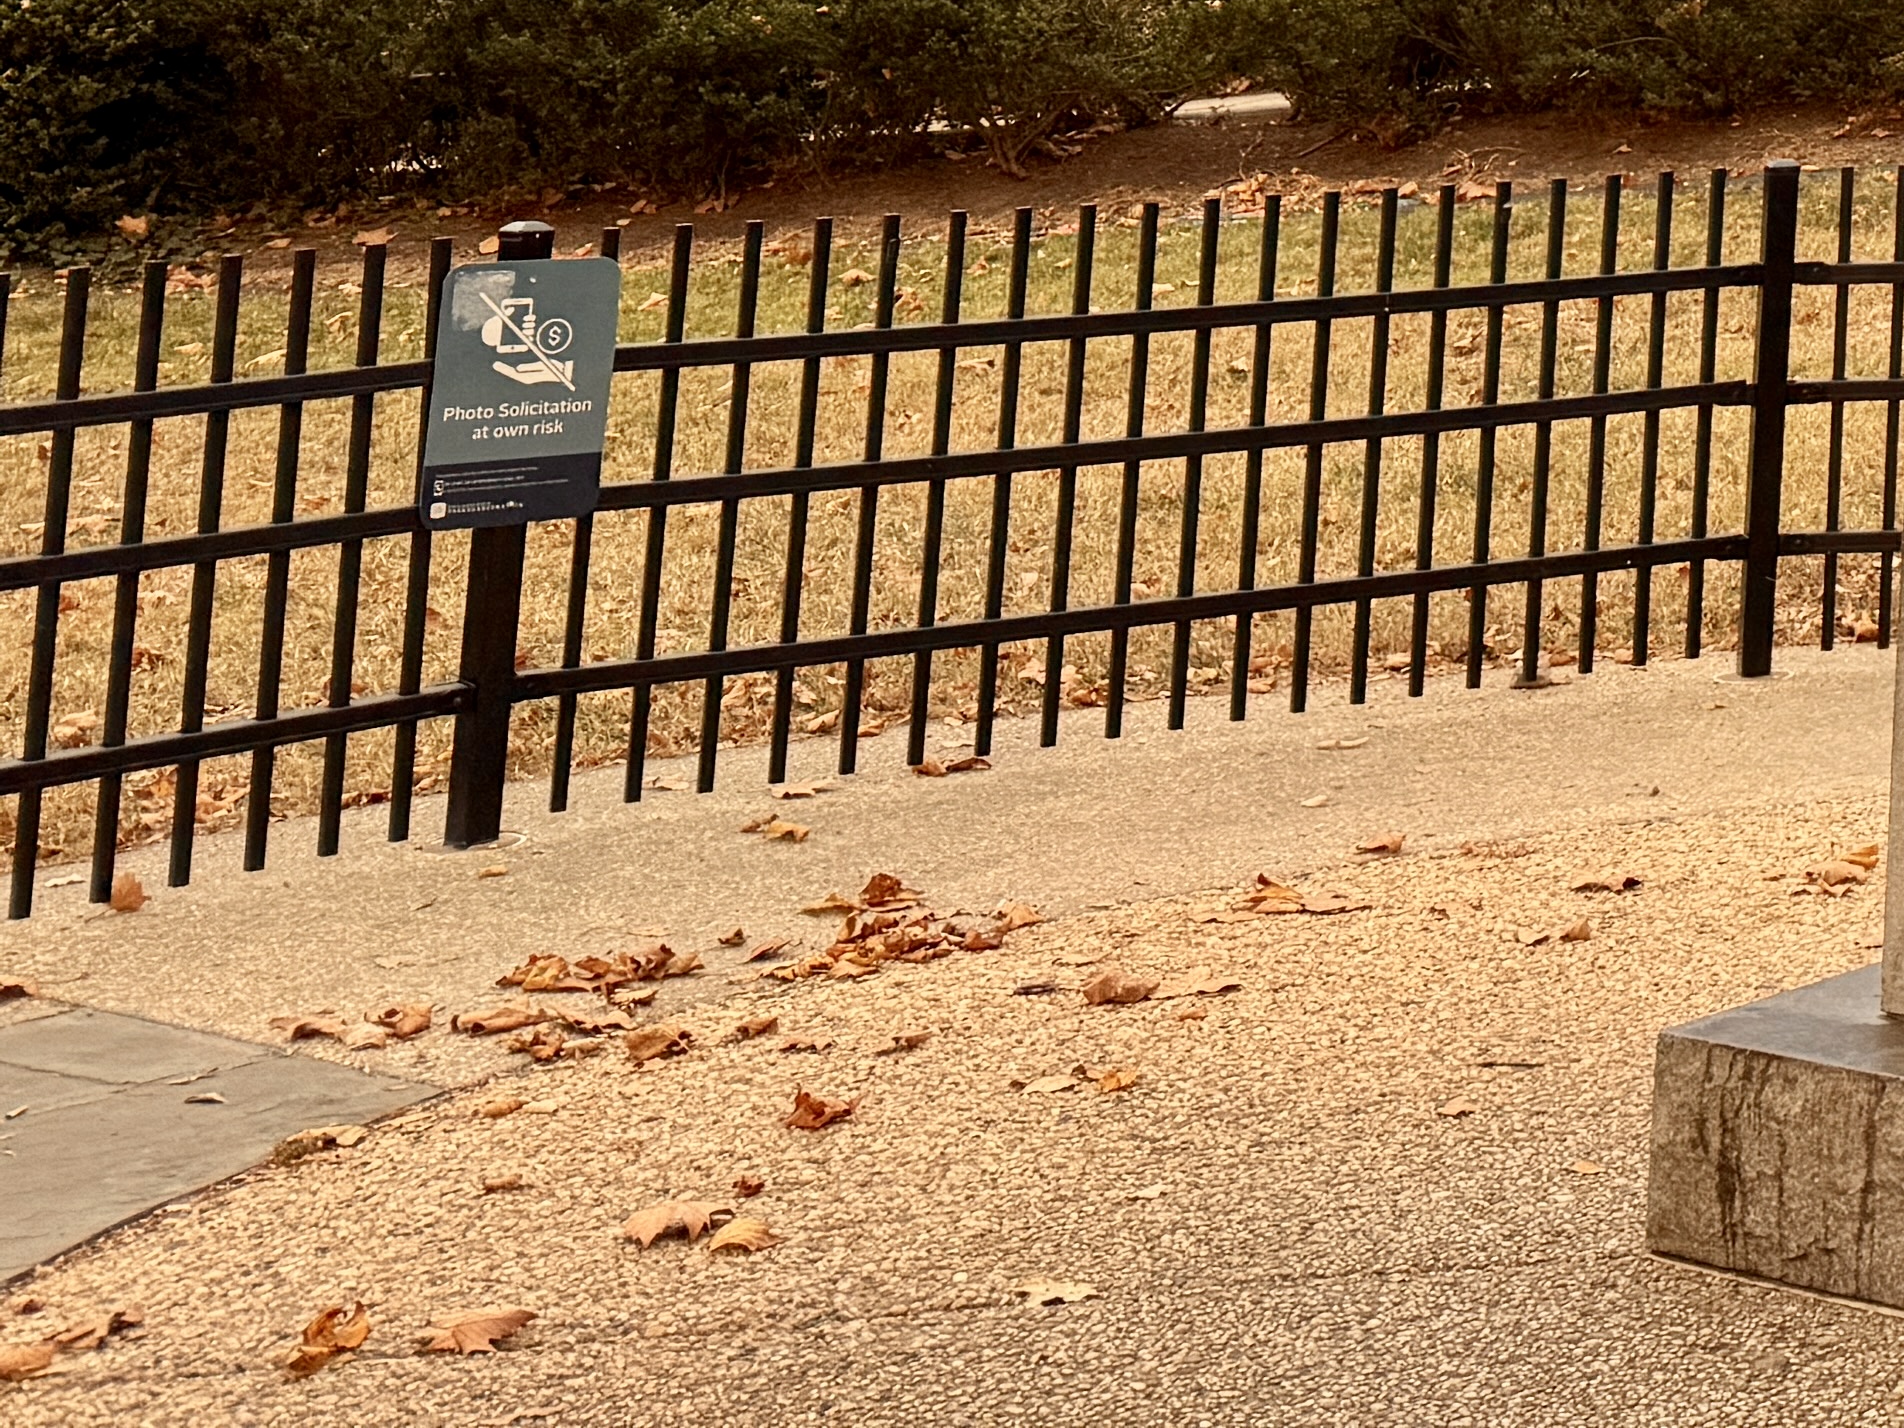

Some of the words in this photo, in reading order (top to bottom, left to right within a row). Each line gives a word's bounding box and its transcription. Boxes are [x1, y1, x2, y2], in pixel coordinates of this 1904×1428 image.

[443, 406, 494, 422] Photo
[498, 398, 592, 418] Solicitation
[472, 425, 489, 440] at
[493, 425, 529, 439] own
[532, 419, 563, 435] risk
